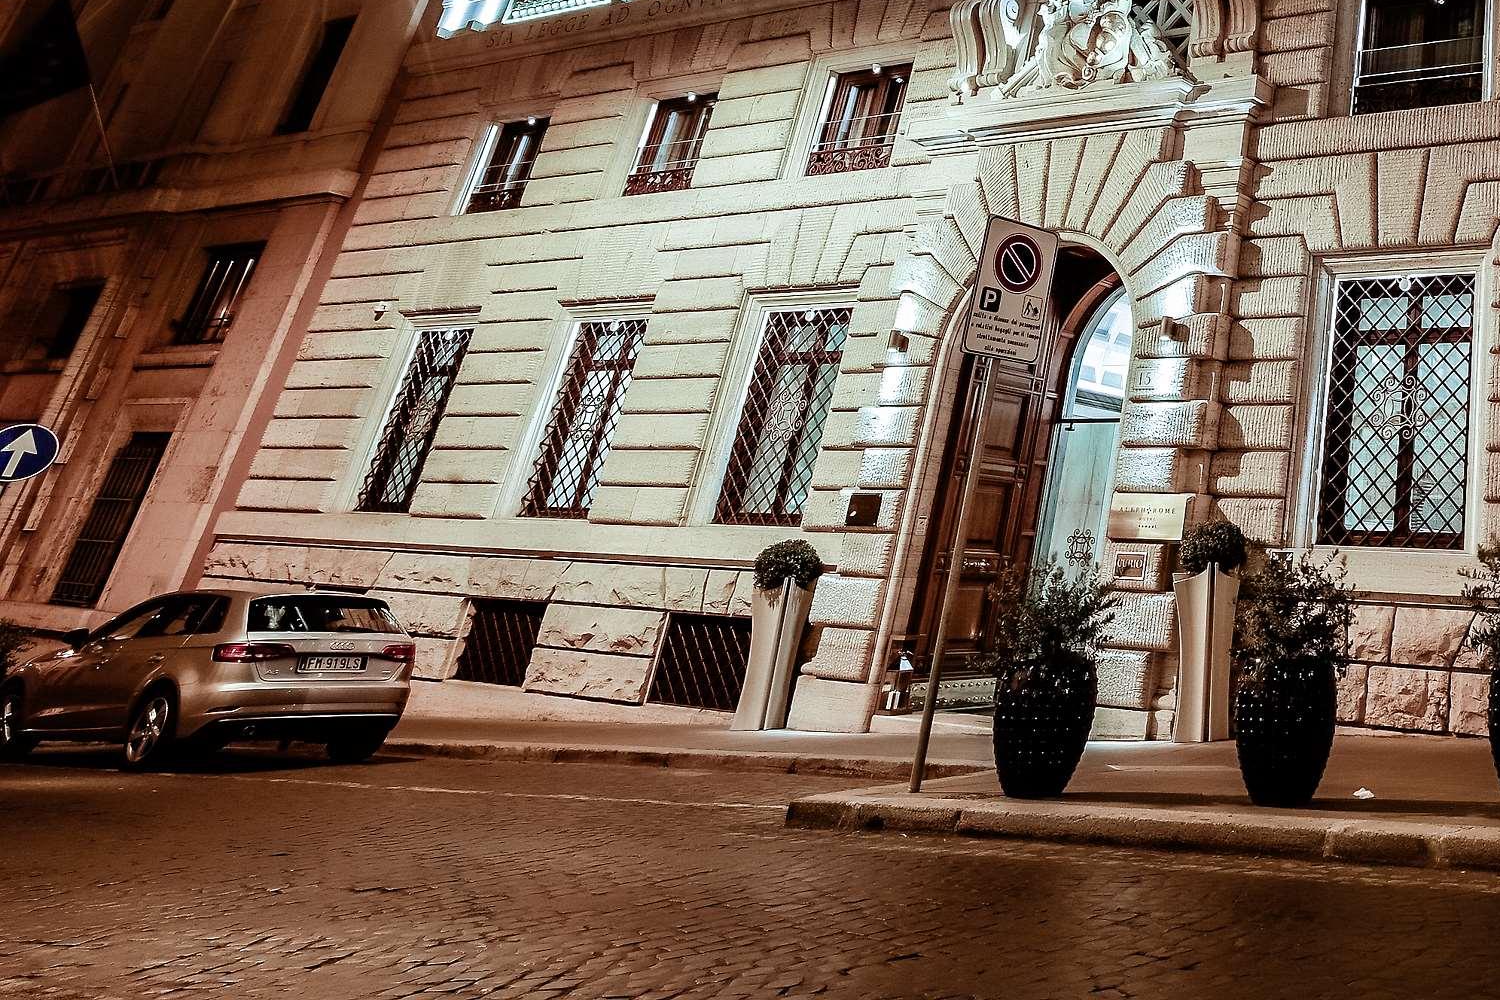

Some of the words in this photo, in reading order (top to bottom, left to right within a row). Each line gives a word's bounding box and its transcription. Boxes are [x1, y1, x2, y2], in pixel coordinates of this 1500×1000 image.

[524, 13, 591, 41] LEGGE
[600, 5, 631, 26] AD
[983, 289, 997, 308] P
[1138, 371, 1152, 386] 15
